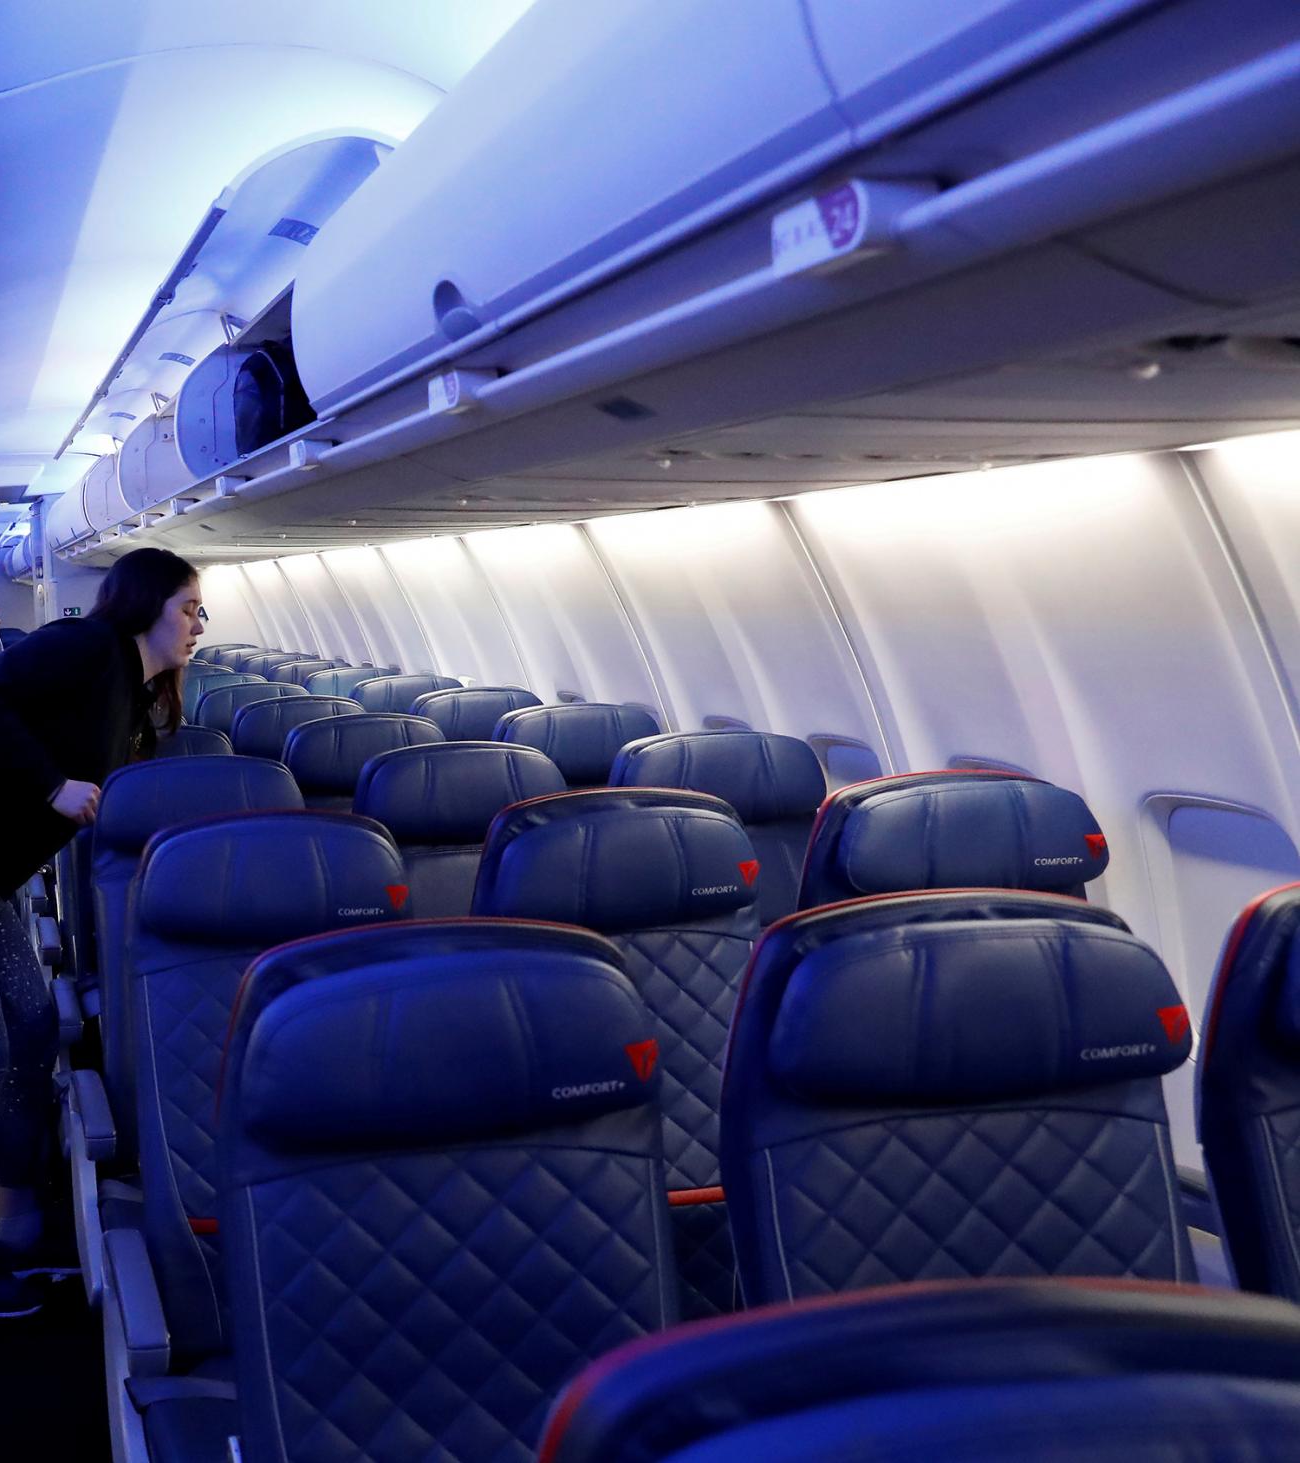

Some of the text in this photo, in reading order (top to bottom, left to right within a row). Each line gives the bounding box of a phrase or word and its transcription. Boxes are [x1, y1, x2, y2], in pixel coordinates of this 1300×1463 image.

[1034, 856, 1084, 866] COMFORT+
[692, 884, 738, 896] COMFORT+
[338, 907, 385, 917] COMFORT+
[1080, 1042, 1158, 1061] COMFORT+
[552, 1079, 627, 1100] COMFORT+
